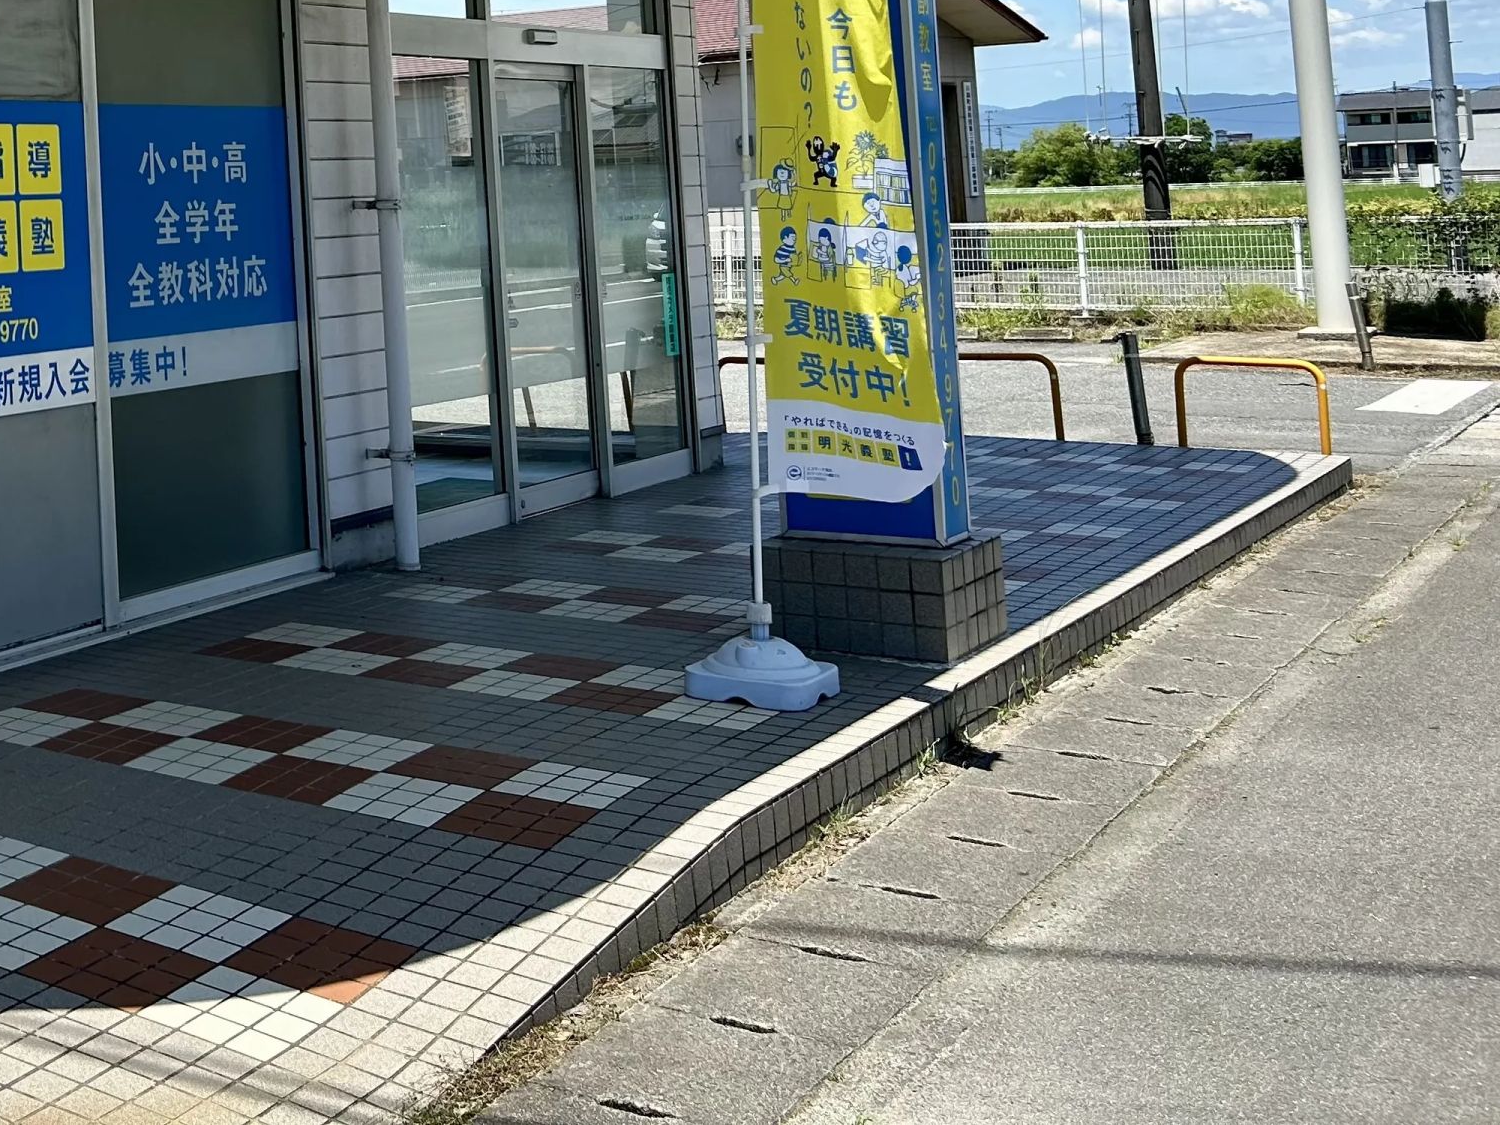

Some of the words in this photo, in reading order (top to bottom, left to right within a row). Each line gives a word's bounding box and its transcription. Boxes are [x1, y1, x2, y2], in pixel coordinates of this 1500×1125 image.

[154, 198, 240, 245] 全学年
[128, 255, 268, 309] 全教科対応
[784, 298, 910, 358] 夏期講習
[798, 352, 910, 407] 受付中!
[818, 435, 912, 466] 明光義塾!
